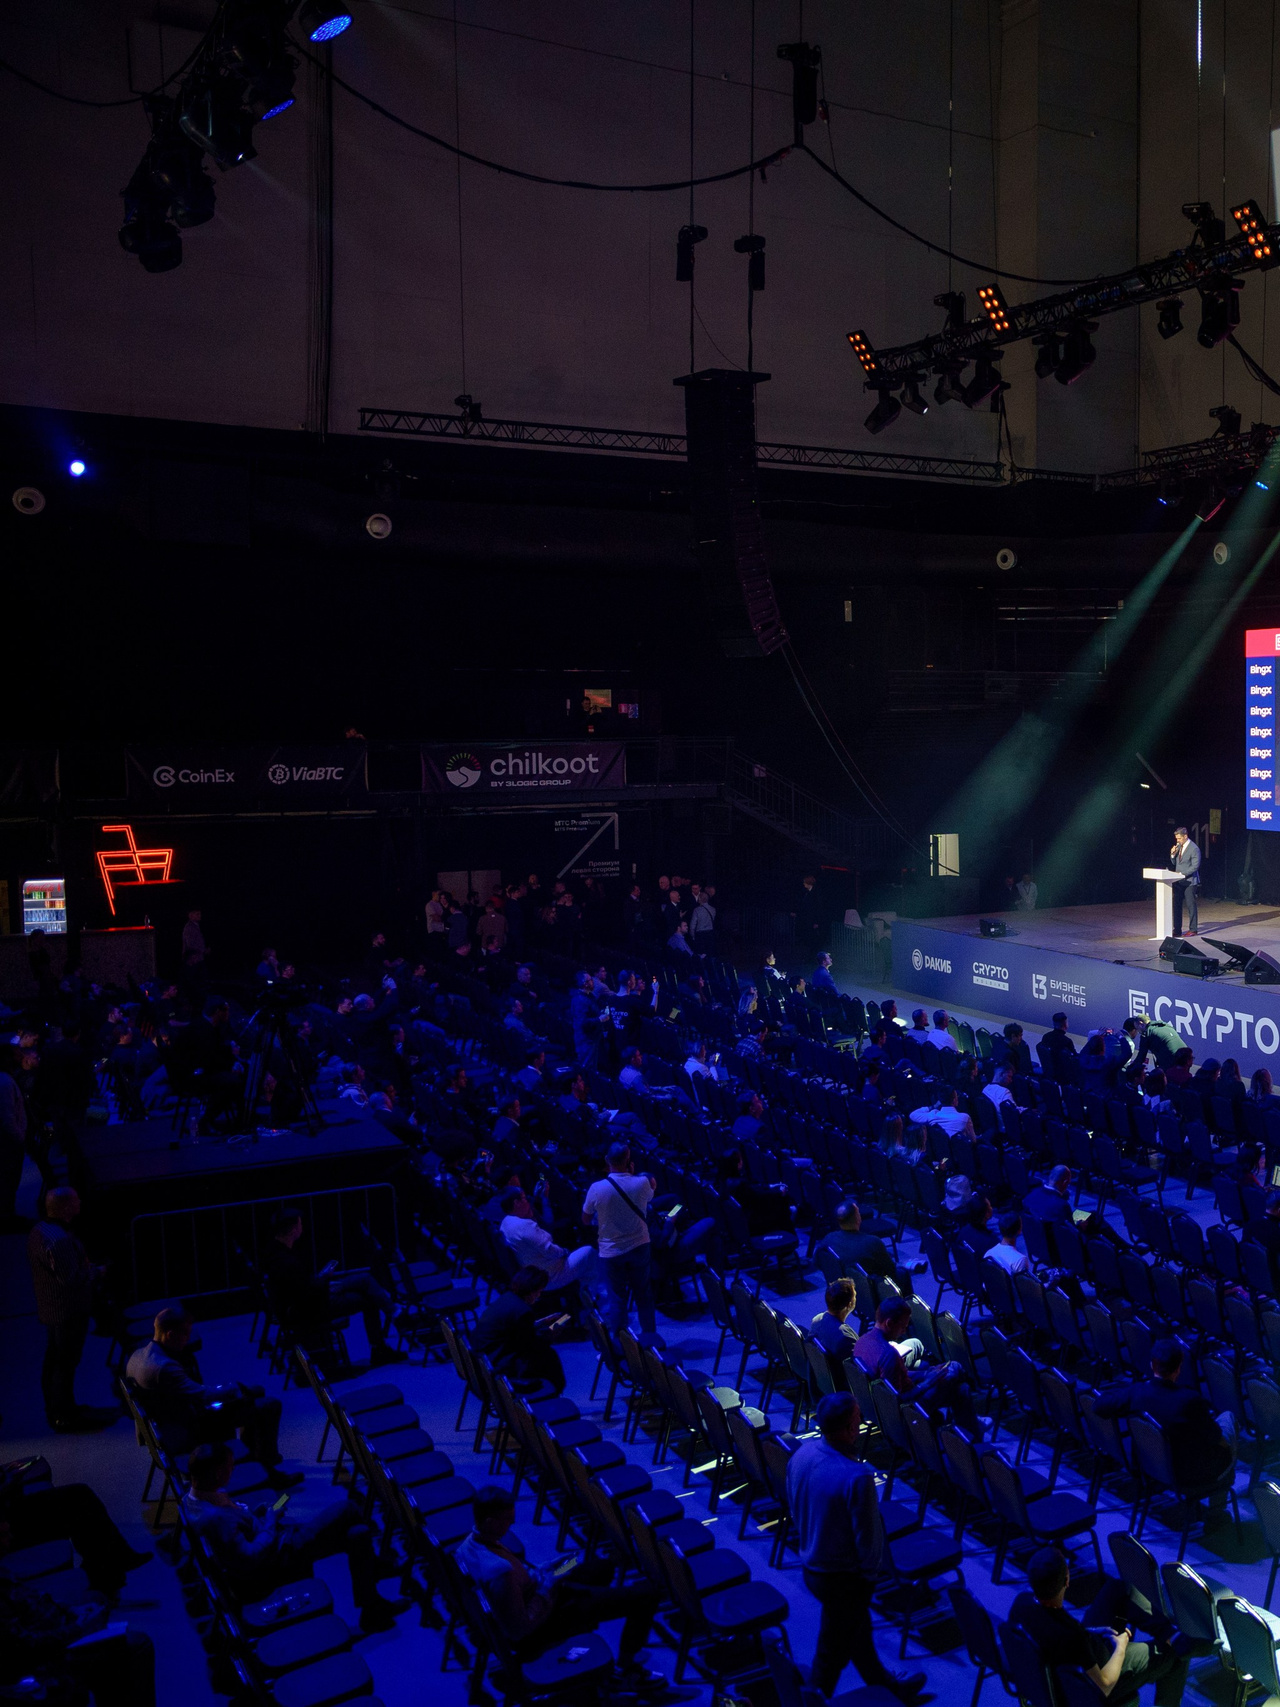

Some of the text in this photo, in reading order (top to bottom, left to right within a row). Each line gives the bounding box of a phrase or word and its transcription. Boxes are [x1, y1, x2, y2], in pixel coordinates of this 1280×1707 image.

[490, 752, 600, 776] chilkoot
[178, 768, 235, 783] CoinEx
[291, 766, 345, 781] ViaBTC
[490, 780, 504, 788] BY
[924, 955, 952, 974] РАКИБ
[972, 961, 1009, 980] CRYPTO
[1050, 979, 1086, 996] БИЗНЕС
[1154, 995, 1280, 1055] CRYPTO
